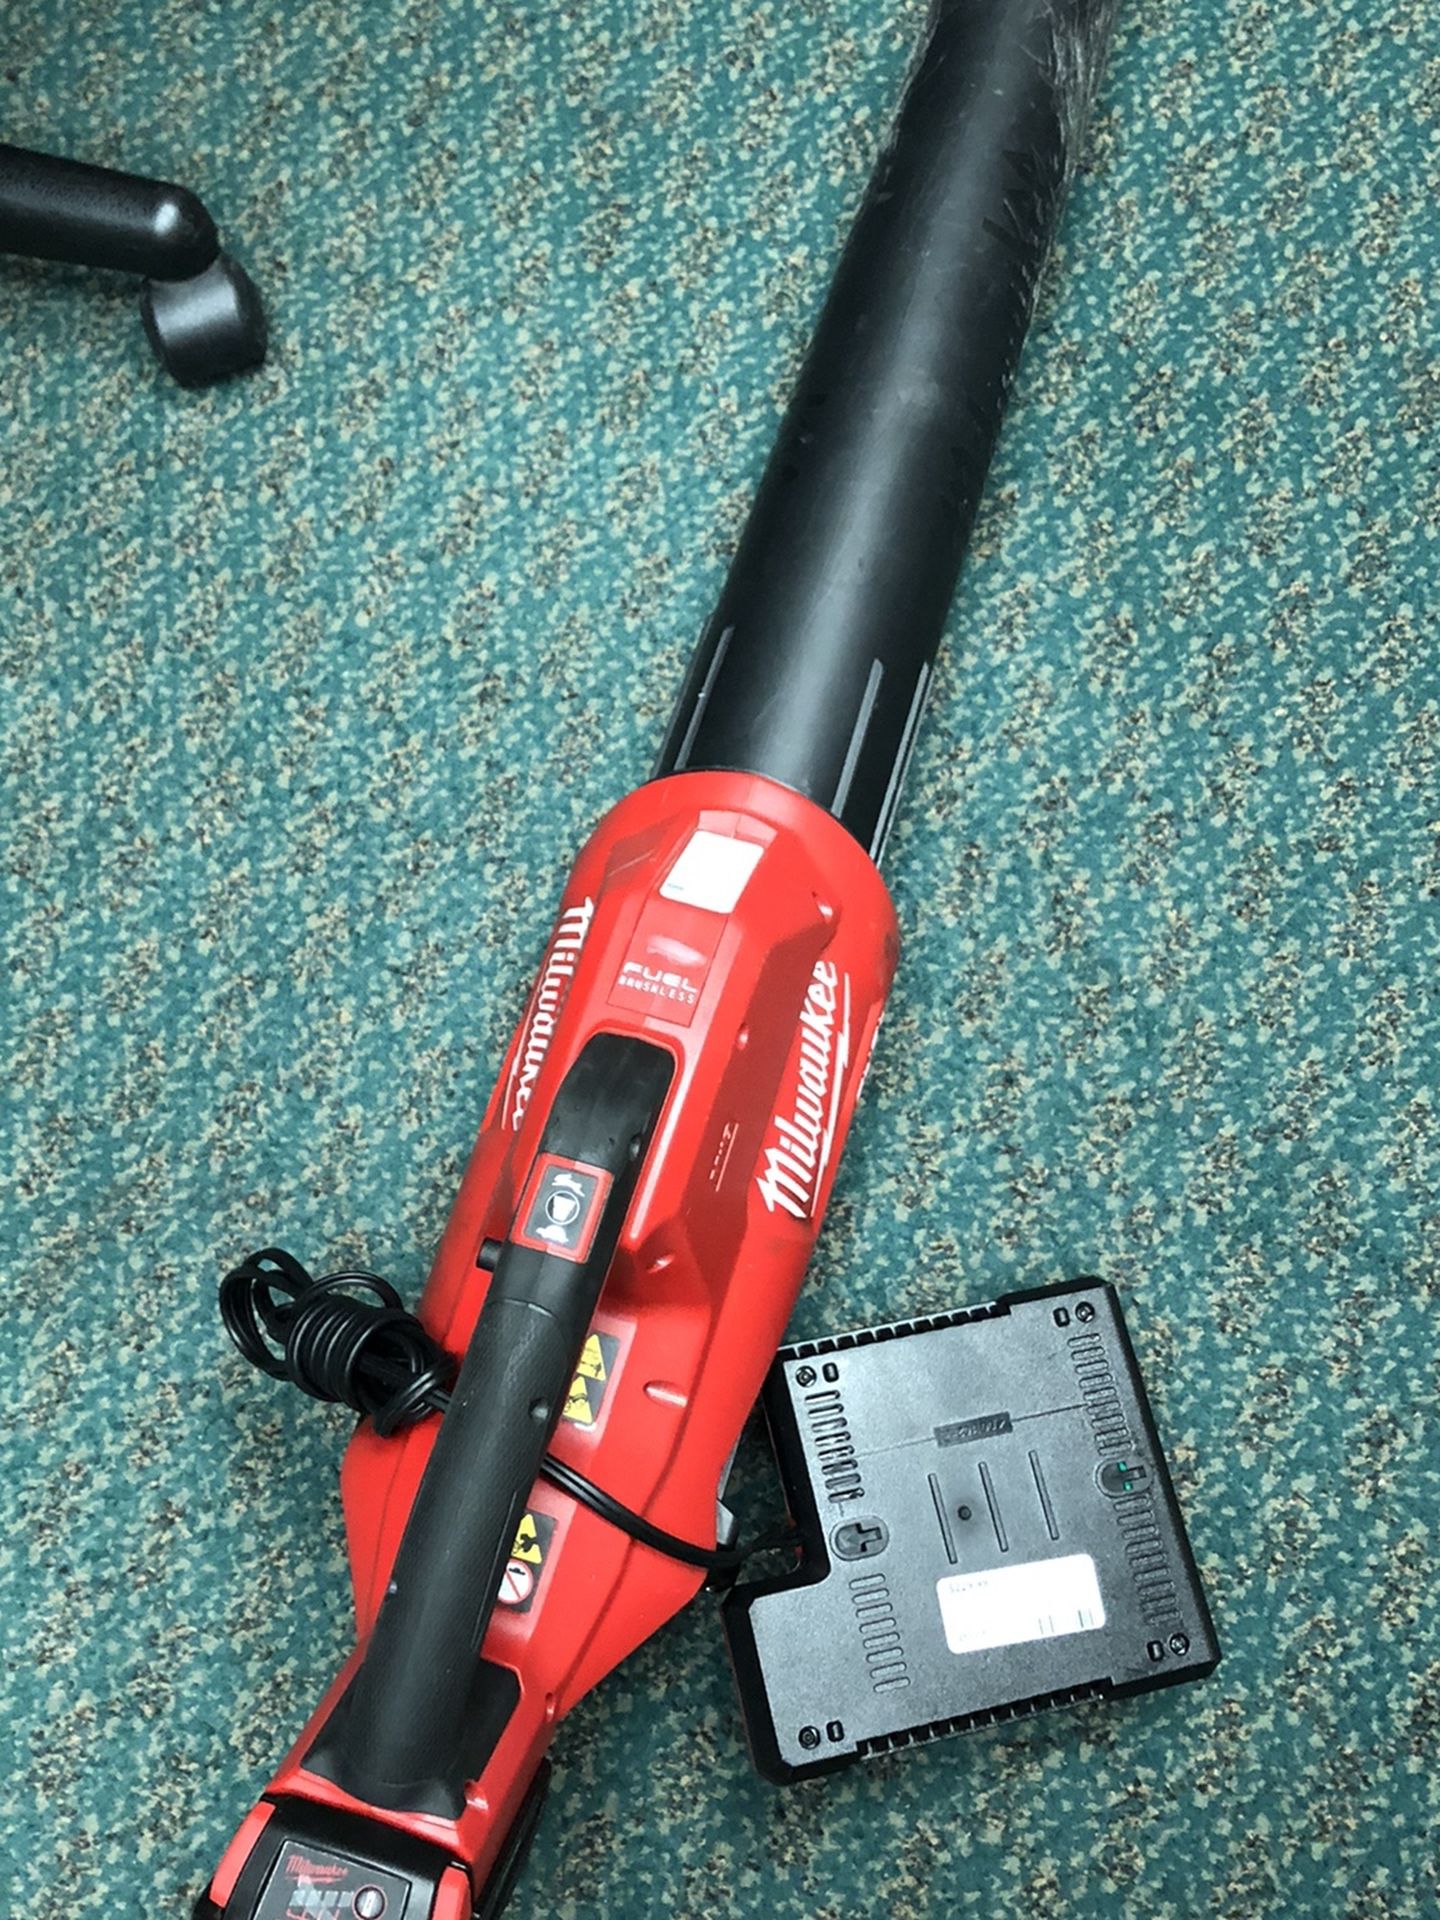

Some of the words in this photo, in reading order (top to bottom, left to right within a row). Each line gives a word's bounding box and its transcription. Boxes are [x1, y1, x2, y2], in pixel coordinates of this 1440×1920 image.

[619, 974, 695, 1005] BRUSHLESS
[622, 961, 698, 994] FUEL
[756, 960, 838, 1219] Milwaukee
[285, 1855, 348, 1877] Milwaukee
